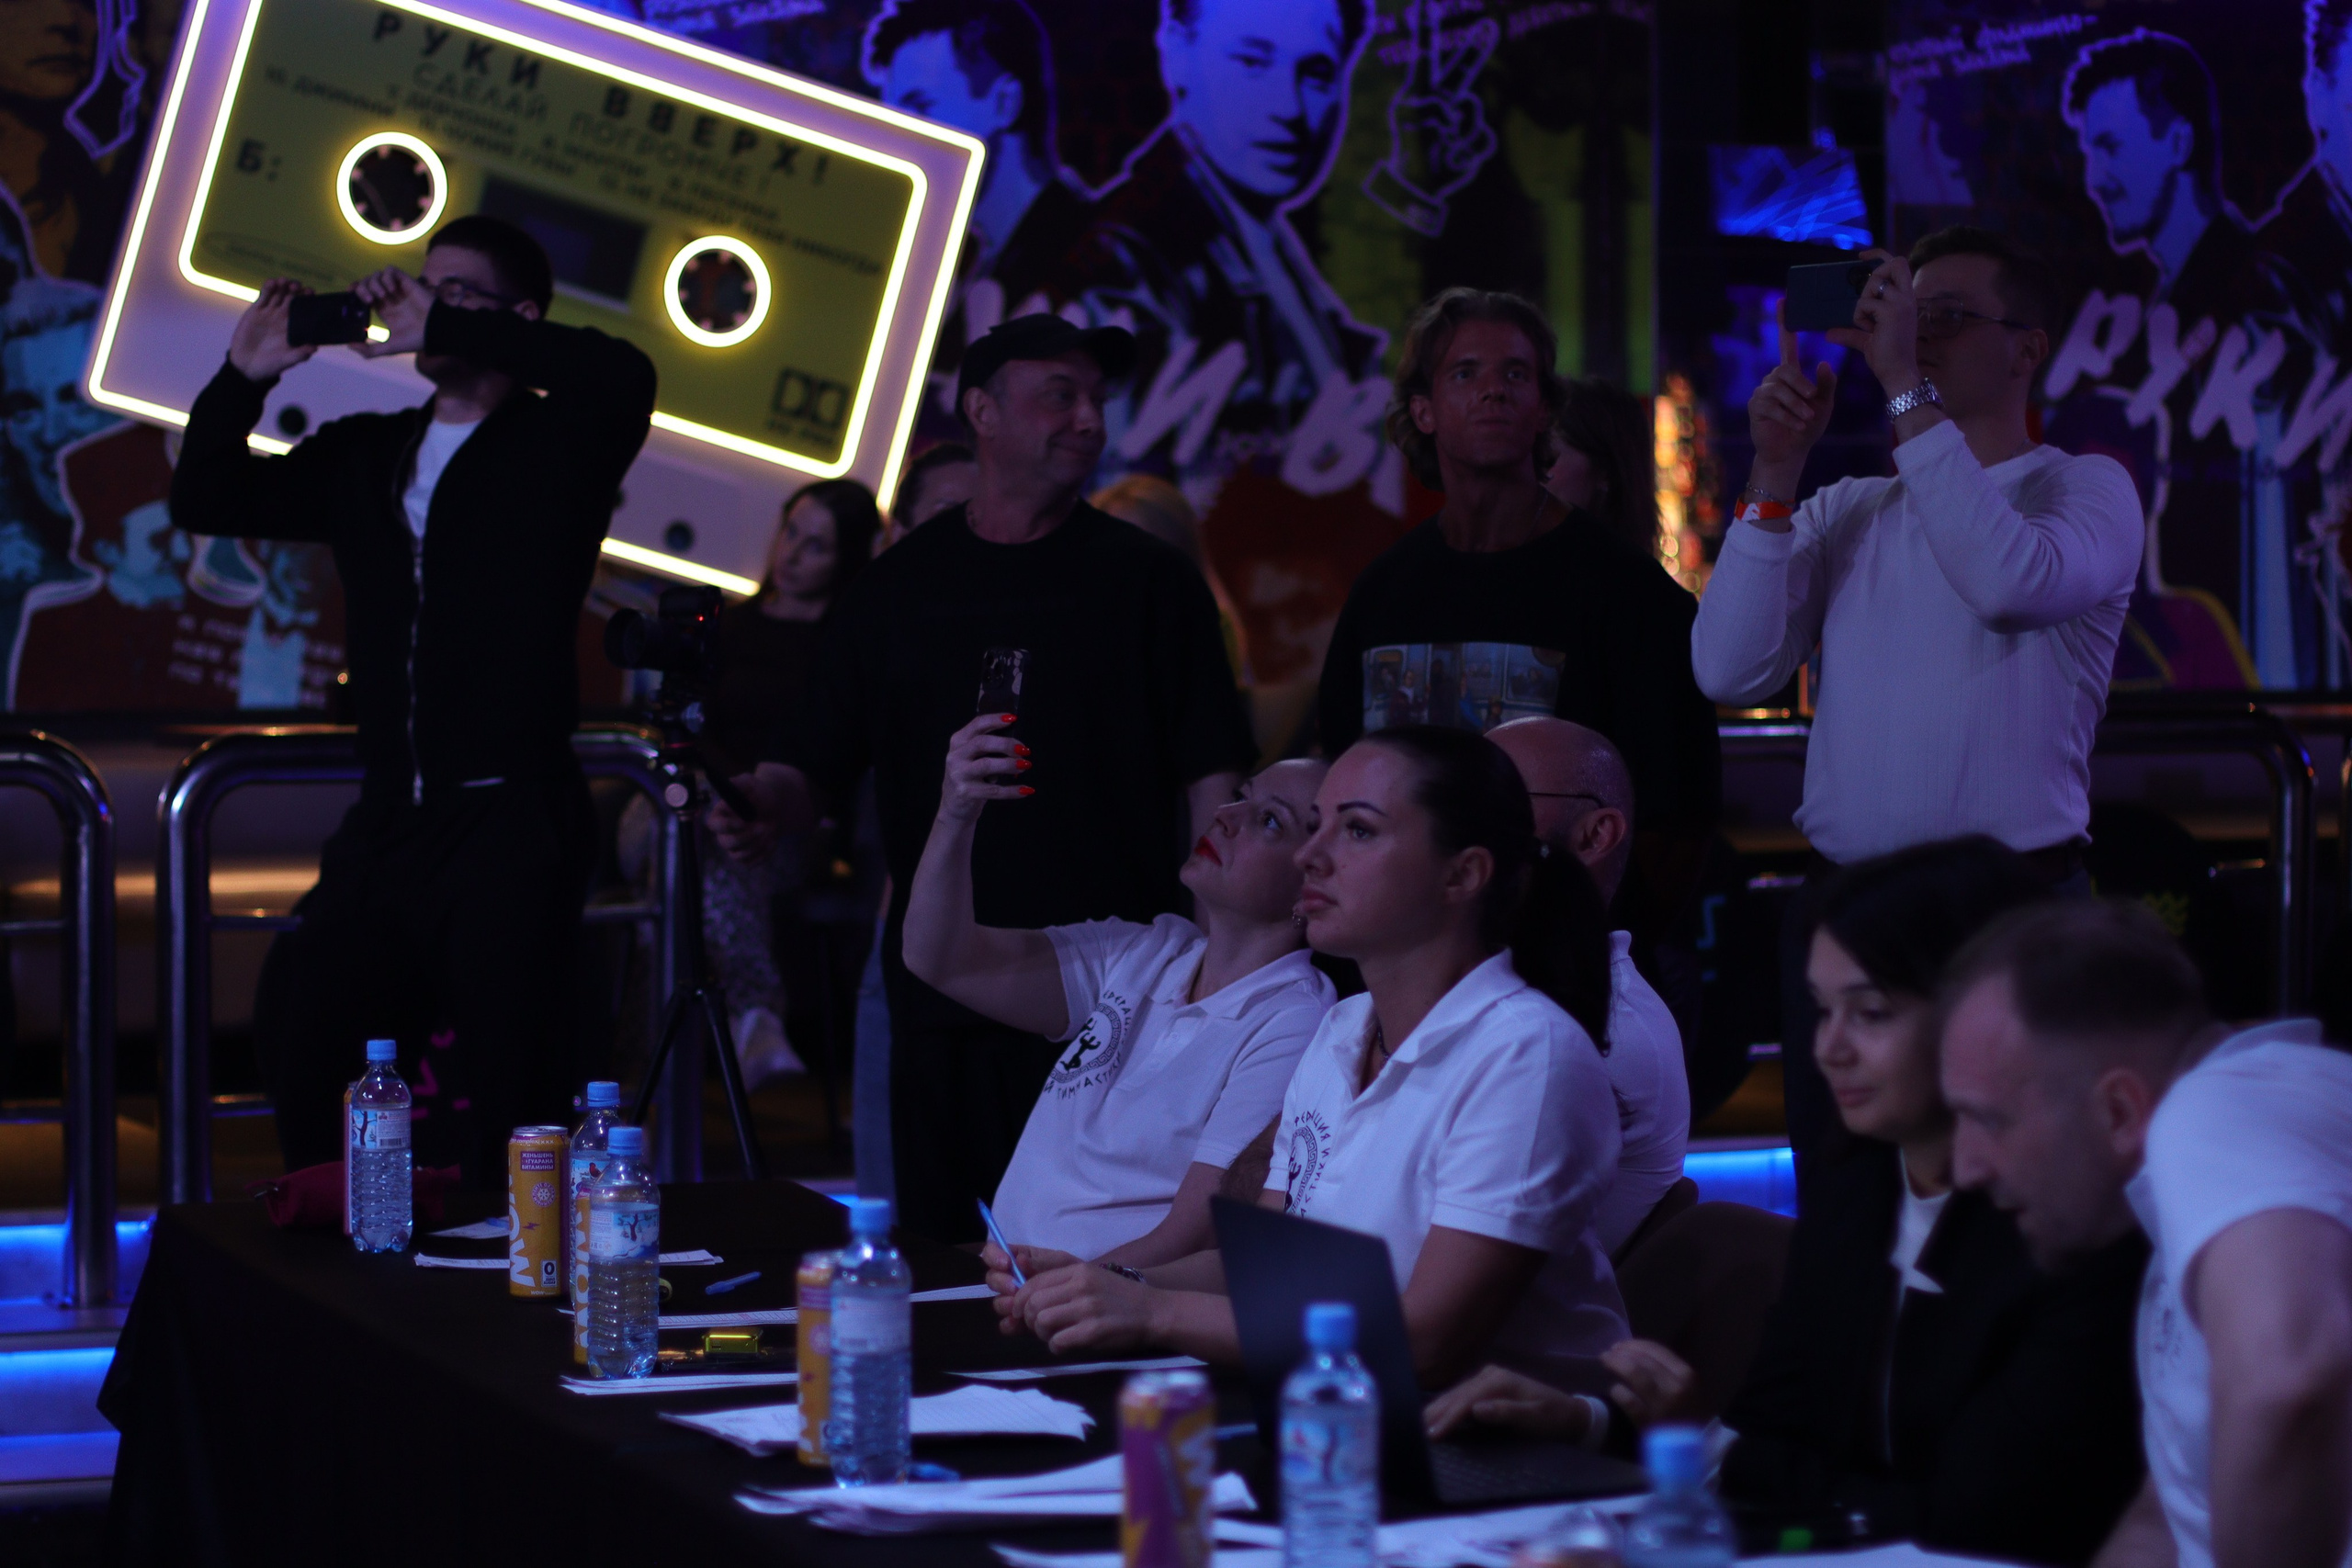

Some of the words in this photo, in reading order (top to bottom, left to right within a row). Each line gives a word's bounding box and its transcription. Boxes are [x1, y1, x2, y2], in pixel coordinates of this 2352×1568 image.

[373, 10, 542, 89] РУКИ
[604, 86, 830, 186] ВВЕРХ!
[415, 62, 548, 123] СДЕЛАЙ
[236, 140, 283, 181] Б:
[544, 1262, 555, 1275] 0
